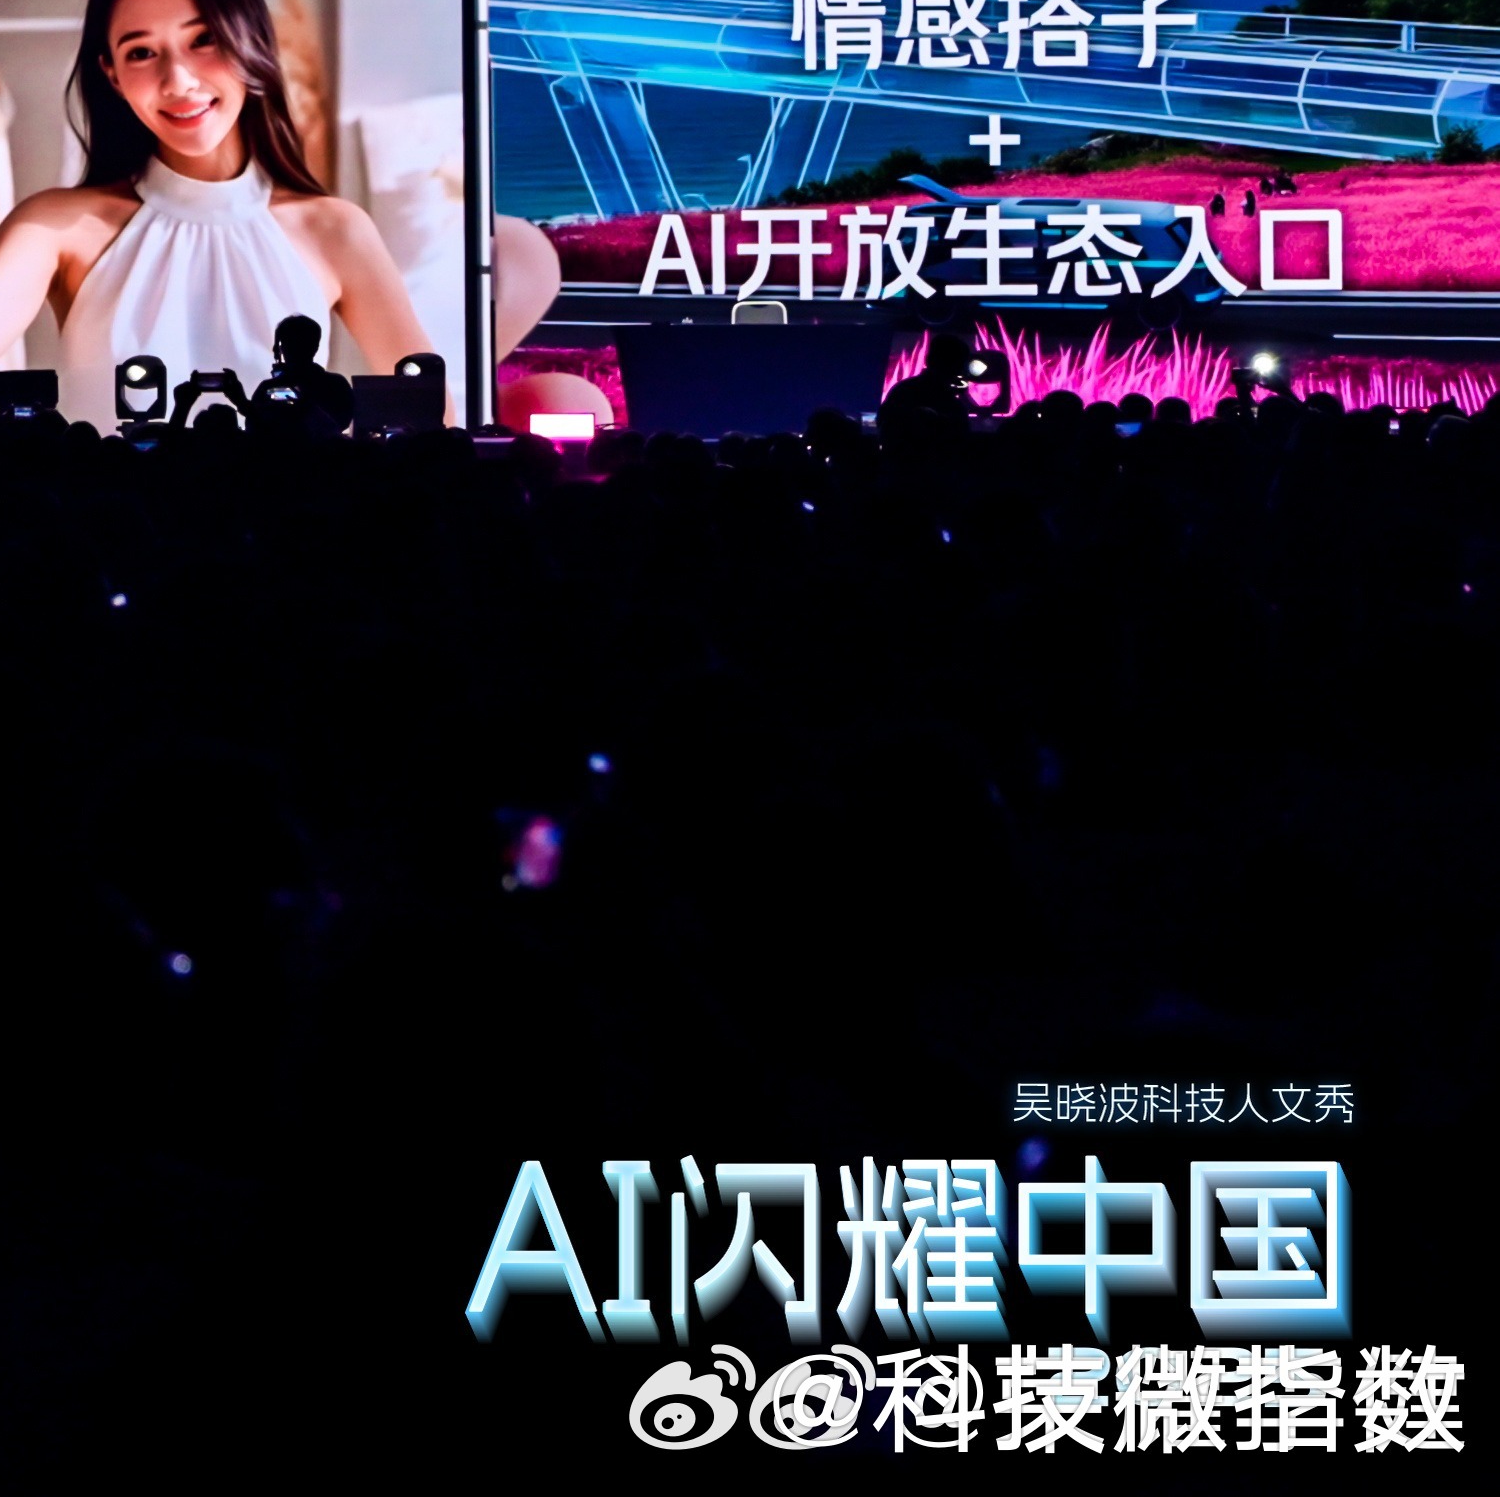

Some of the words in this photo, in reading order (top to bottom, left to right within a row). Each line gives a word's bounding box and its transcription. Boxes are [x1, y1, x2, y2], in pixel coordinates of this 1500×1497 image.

[638, 203, 1343, 302] AI开放生态入口
